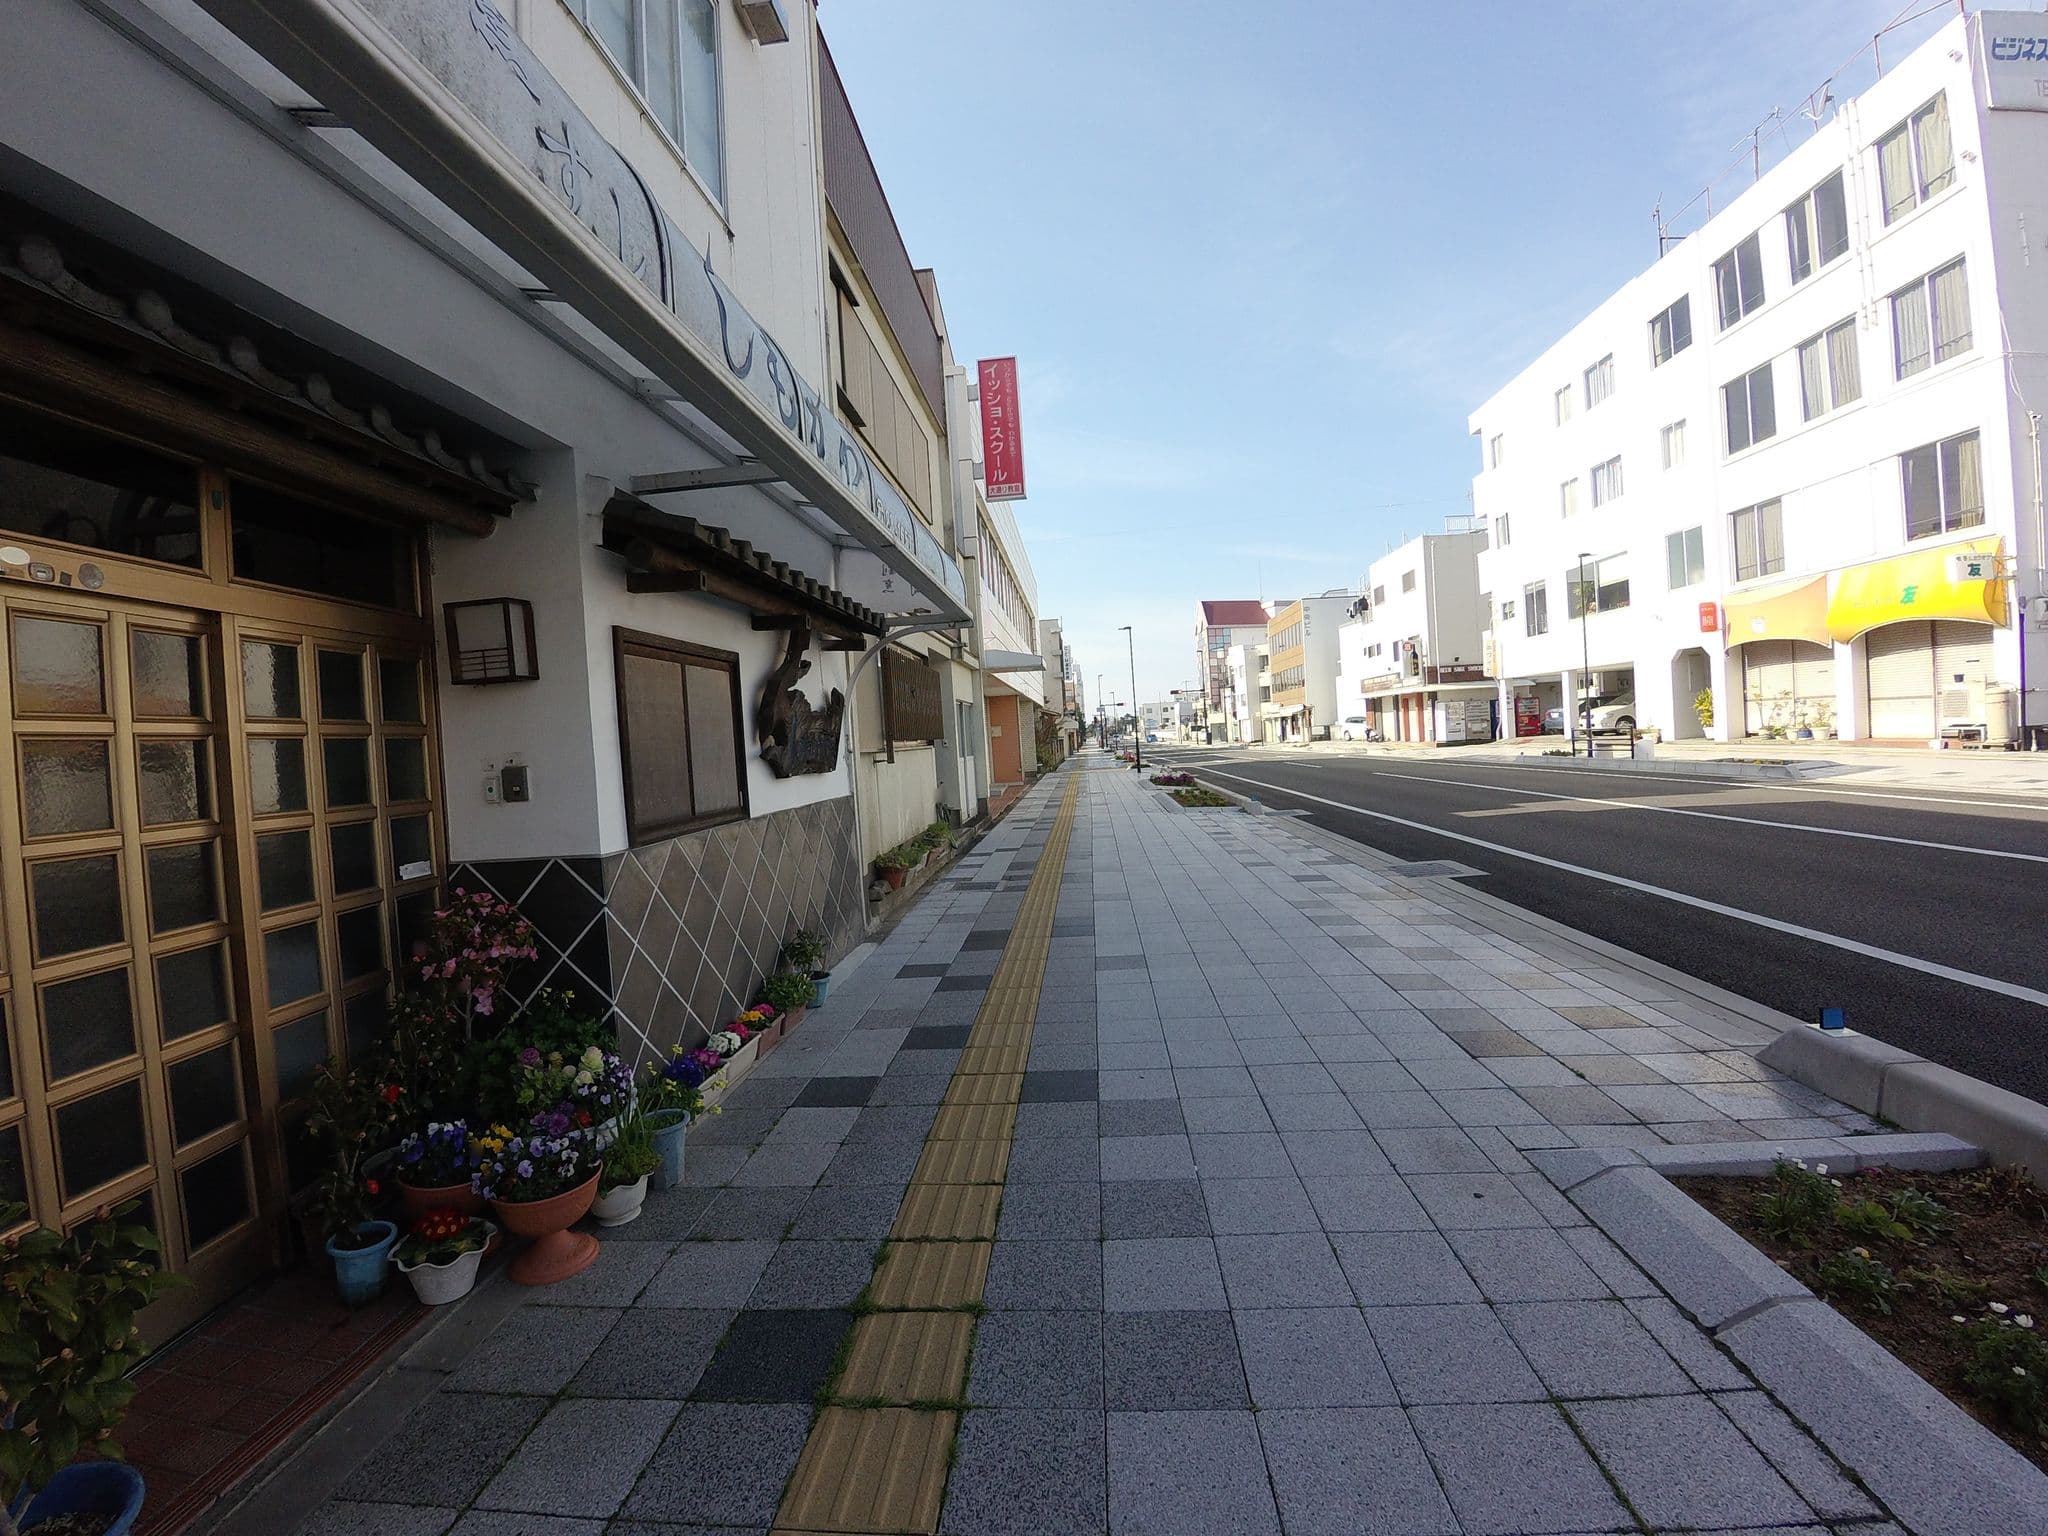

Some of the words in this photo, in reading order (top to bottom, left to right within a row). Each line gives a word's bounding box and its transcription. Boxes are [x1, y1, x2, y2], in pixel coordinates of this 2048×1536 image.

[984, 363, 1008, 482] イッショ・スクール
[1967, 562, 1982, 577] 友
[1900, 584, 1919, 605] 友
[1302, 606, 1312, 637] 中央ビル
